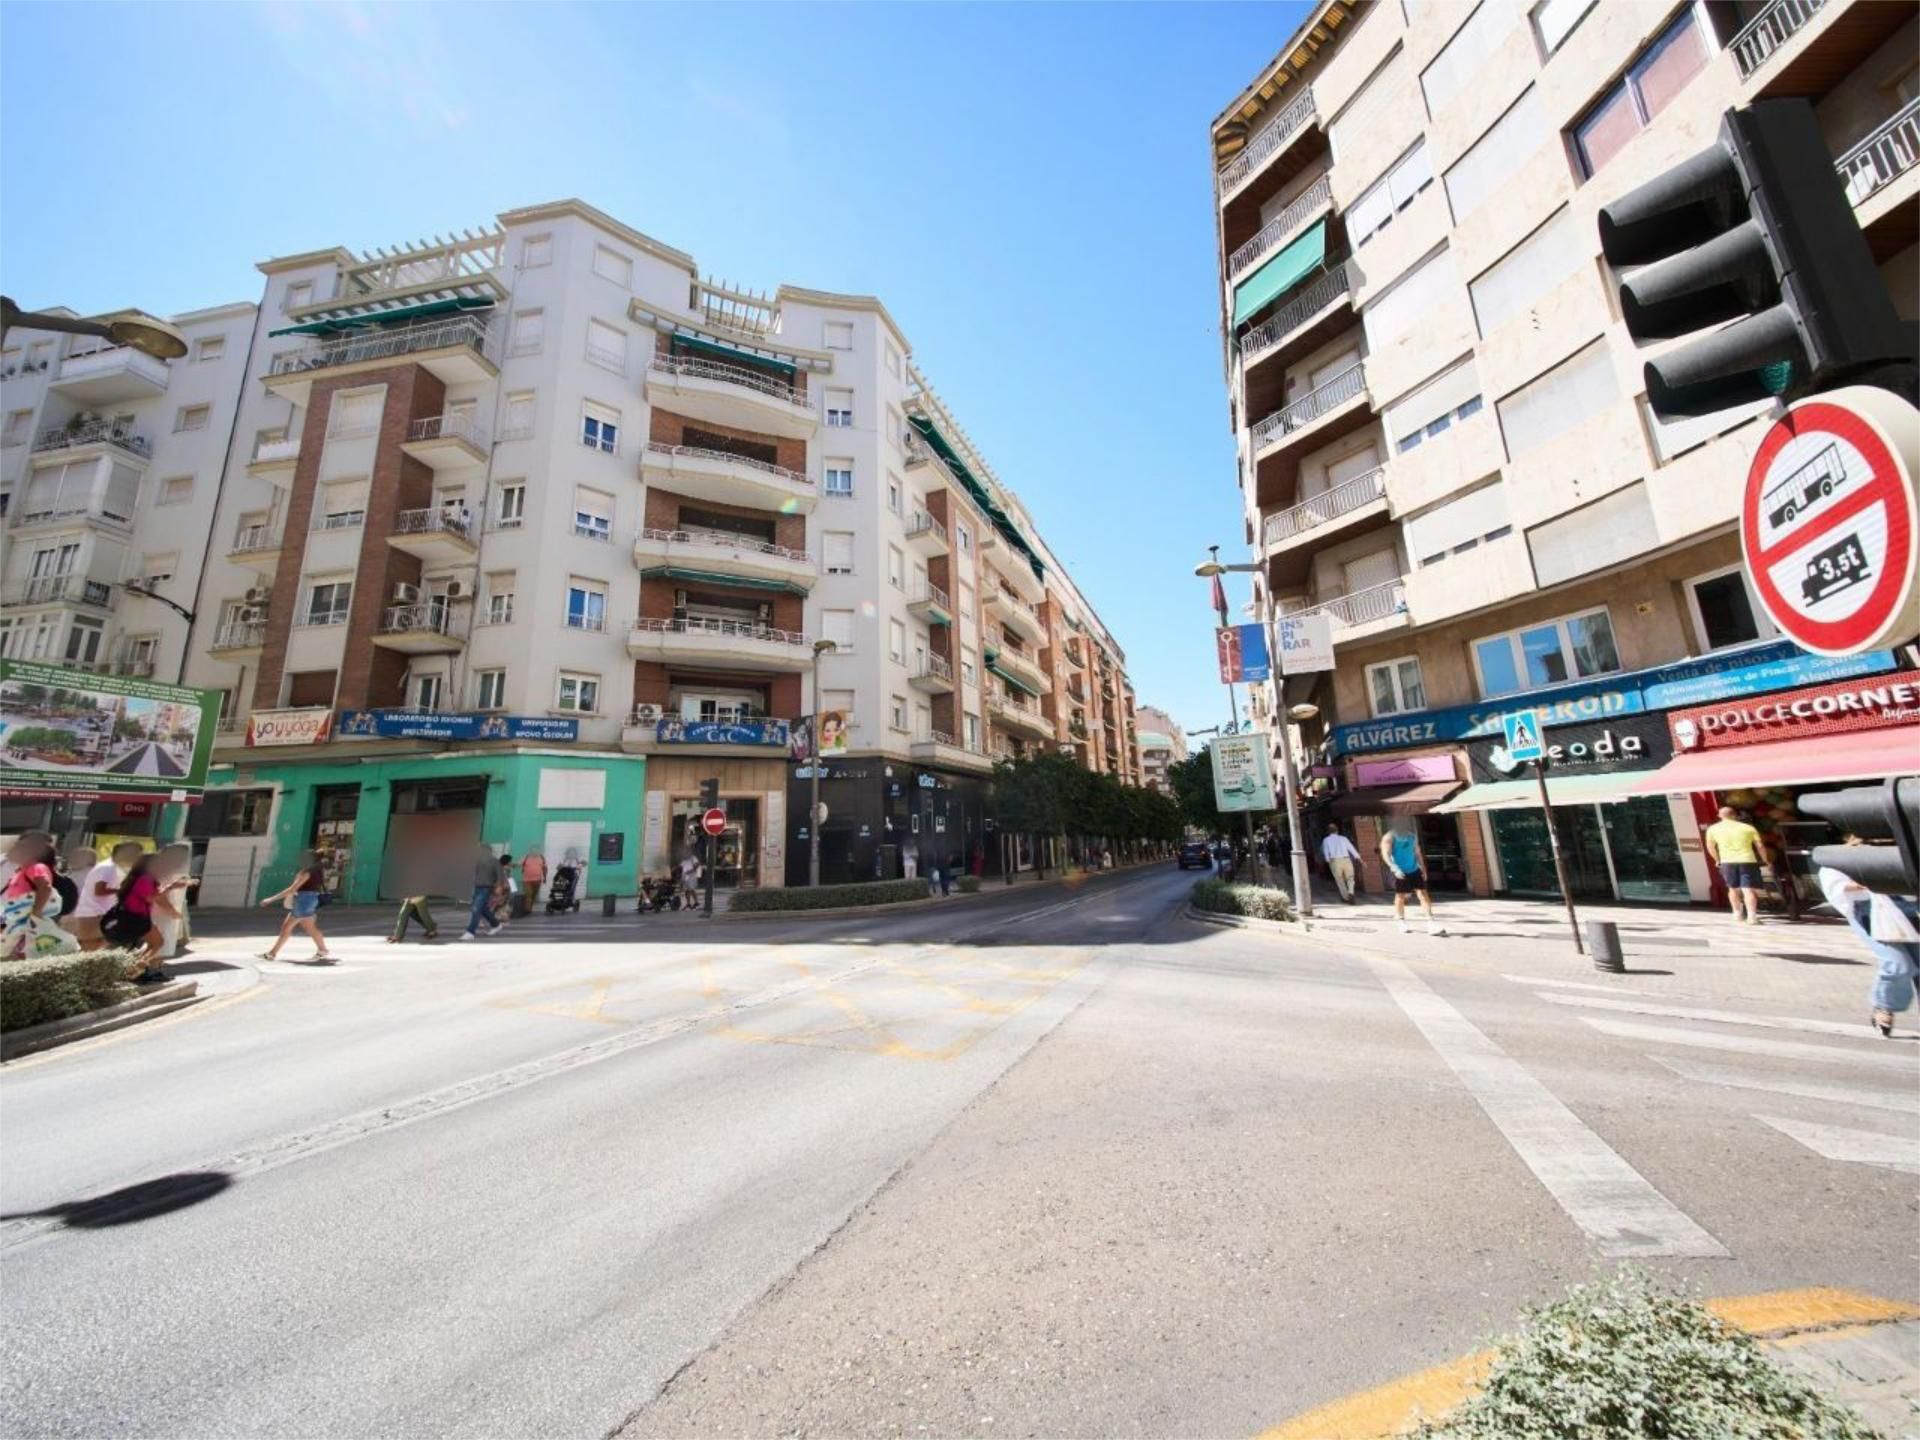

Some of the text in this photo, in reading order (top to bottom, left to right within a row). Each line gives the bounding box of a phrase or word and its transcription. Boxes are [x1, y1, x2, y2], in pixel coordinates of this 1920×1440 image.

[1281, 619, 1304, 631] INS
[1282, 630, 1294, 641] PI
[1283, 638, 1312, 651] RAR
[1657, 665, 1699, 682] Venta
[1705, 660, 1723, 674] de
[1728, 653, 1769, 671] pisos
[1346, 722, 1437, 751] ALVAREZ
[1546, 730, 1641, 759] eoda
